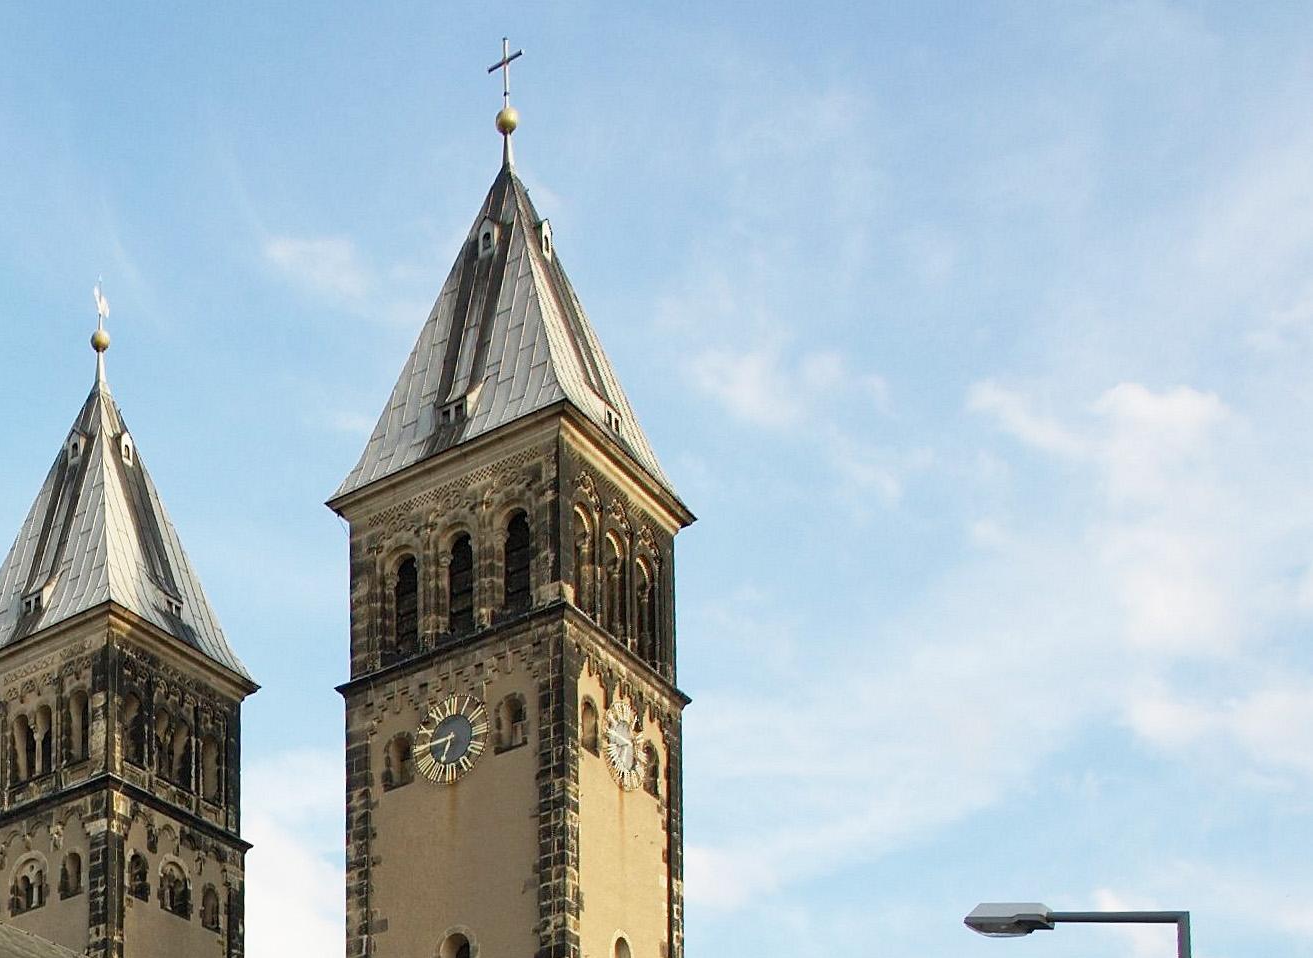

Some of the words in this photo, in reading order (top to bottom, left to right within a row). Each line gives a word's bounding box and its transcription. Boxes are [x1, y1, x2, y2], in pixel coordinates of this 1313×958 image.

[428, 706, 445, 726] XI
[467, 705, 484, 723] II
[418, 724, 435, 737] X
[471, 722, 488, 736] III
